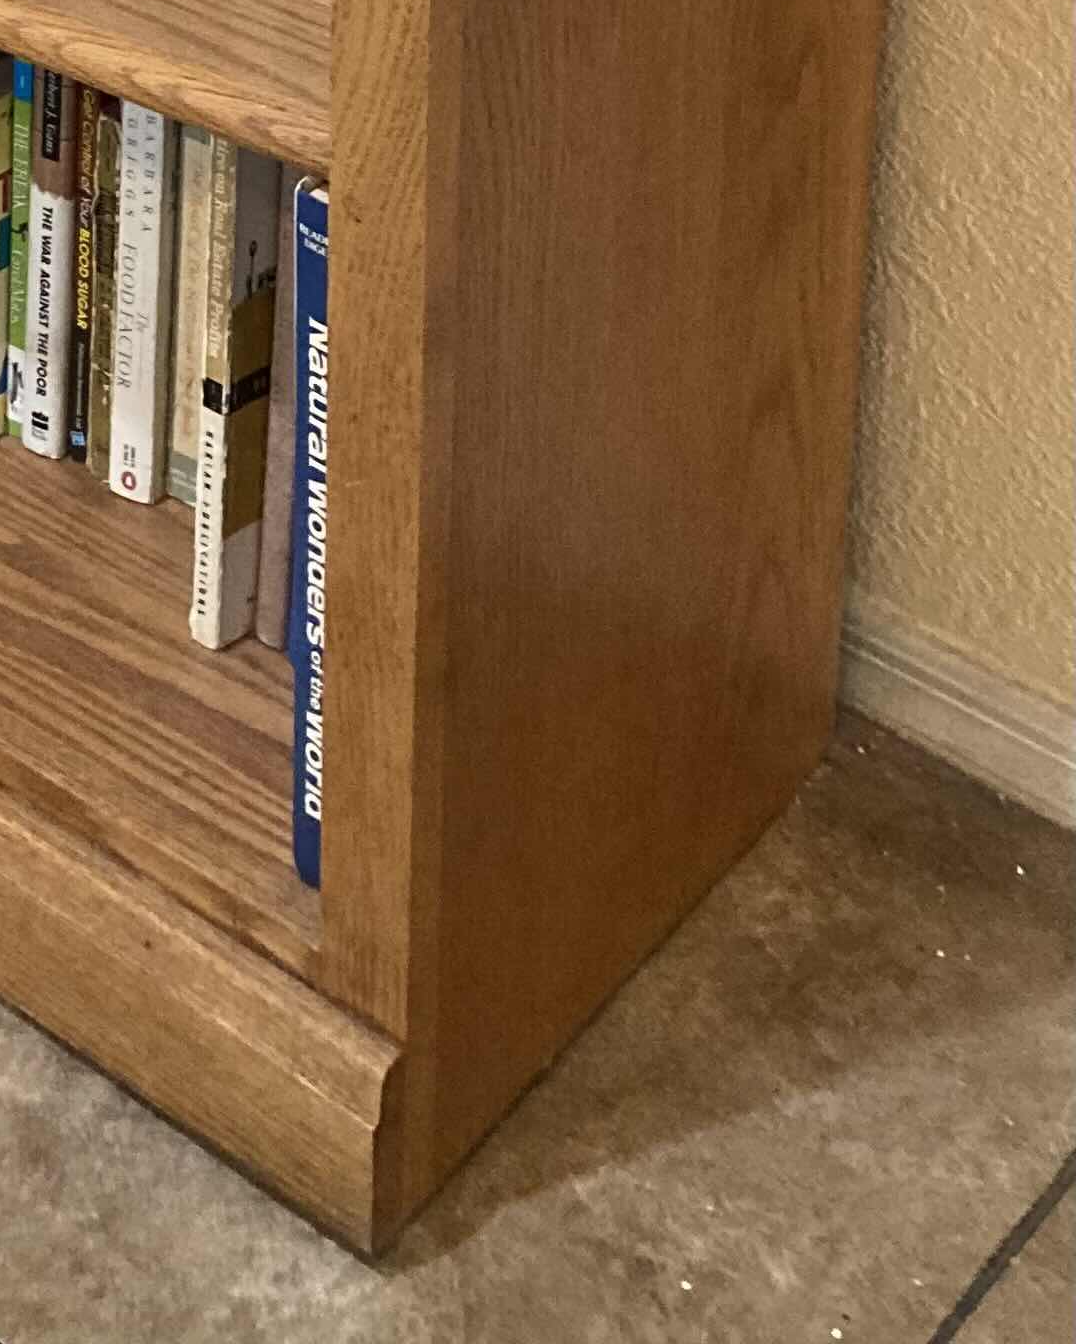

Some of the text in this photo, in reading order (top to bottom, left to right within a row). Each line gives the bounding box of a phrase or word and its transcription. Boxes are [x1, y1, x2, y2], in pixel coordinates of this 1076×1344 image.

[35, 206, 54, 396] THE WAR AGAINST THE POOR
[117, 242, 137, 388] FOOD FACTOR
[304, 315, 329, 821] Natural Wonders of the World
